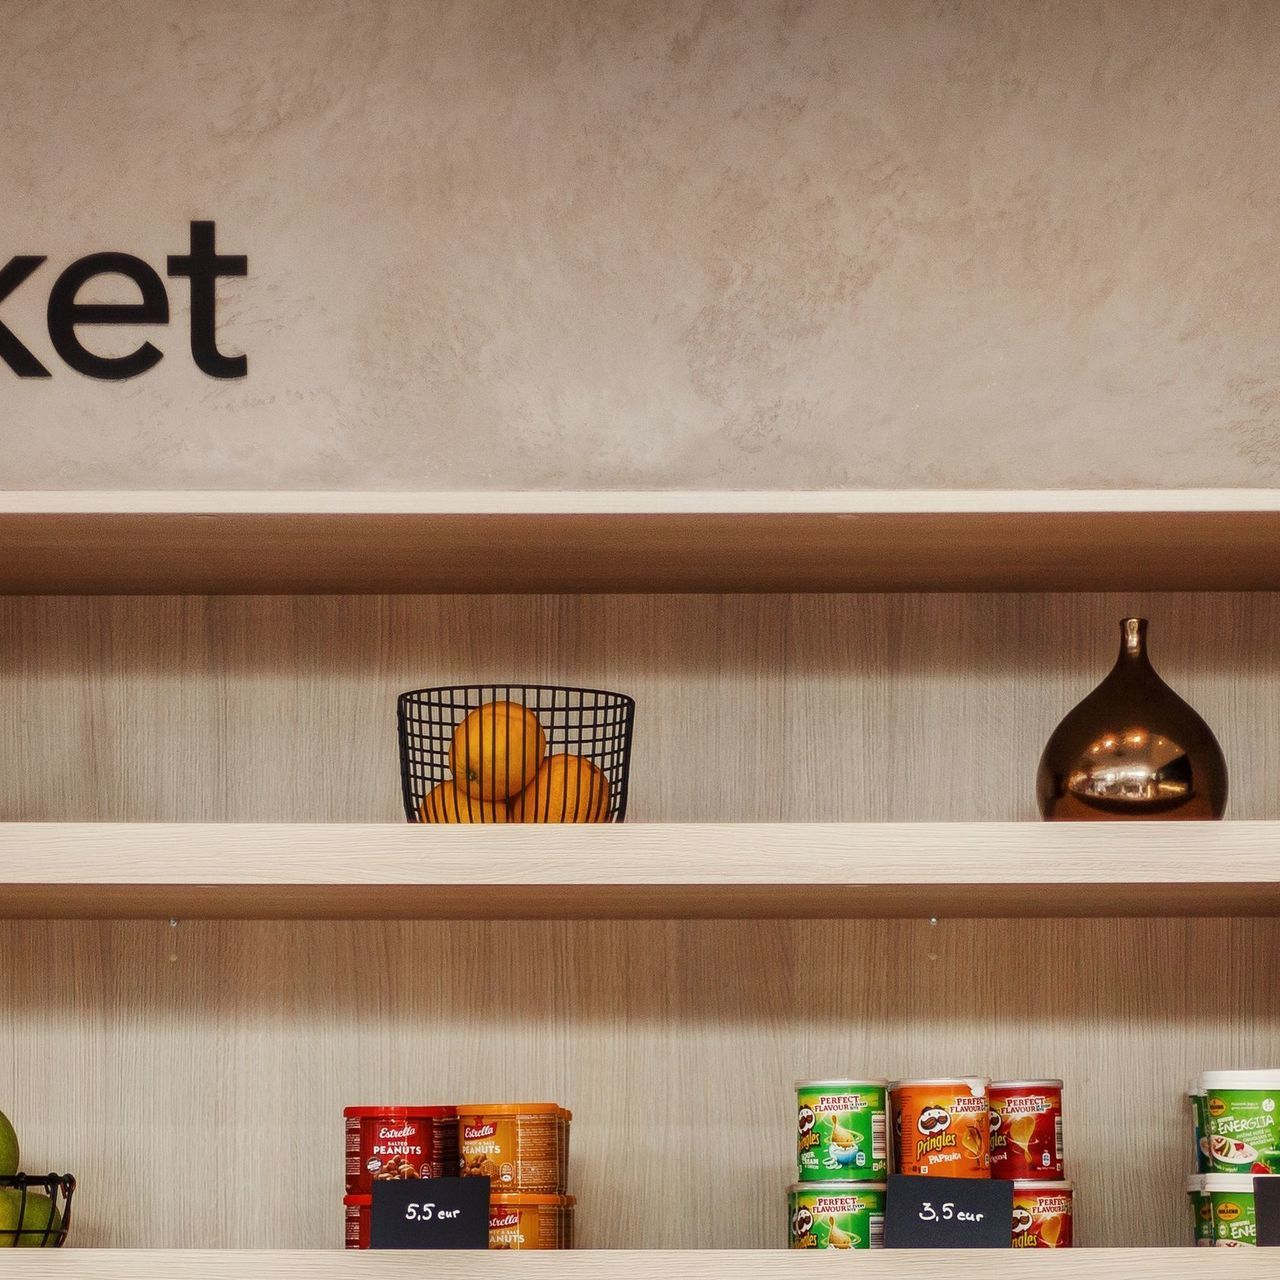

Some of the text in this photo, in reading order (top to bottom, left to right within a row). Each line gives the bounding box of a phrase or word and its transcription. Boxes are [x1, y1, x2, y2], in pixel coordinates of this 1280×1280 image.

[820, 1096, 859, 1104] PERFECT
[1007, 1097, 1044, 1106] PERFECT
[814, 1104, 849, 1112] FLAVOUR
[1001, 1106, 1036, 1114] FLAVOUR
[1218, 1115, 1275, 1134] ENERGIJA
[379, 1125, 416, 1138] Estrella
[465, 1125, 494, 1138] Estrella
[373, 1146, 421, 1154] PEANUTS
[462, 1145, 501, 1154] PEANUTS
[917, 1132, 956, 1161] Pringles
[928, 1152, 961, 1164] PAPRIKA
[817, 1198, 858, 1206] PERFECT
[812, 1205, 848, 1213] FLAVOUR
[488, 1215, 519, 1227] strella
[489, 1235, 525, 1243] ANUTS
